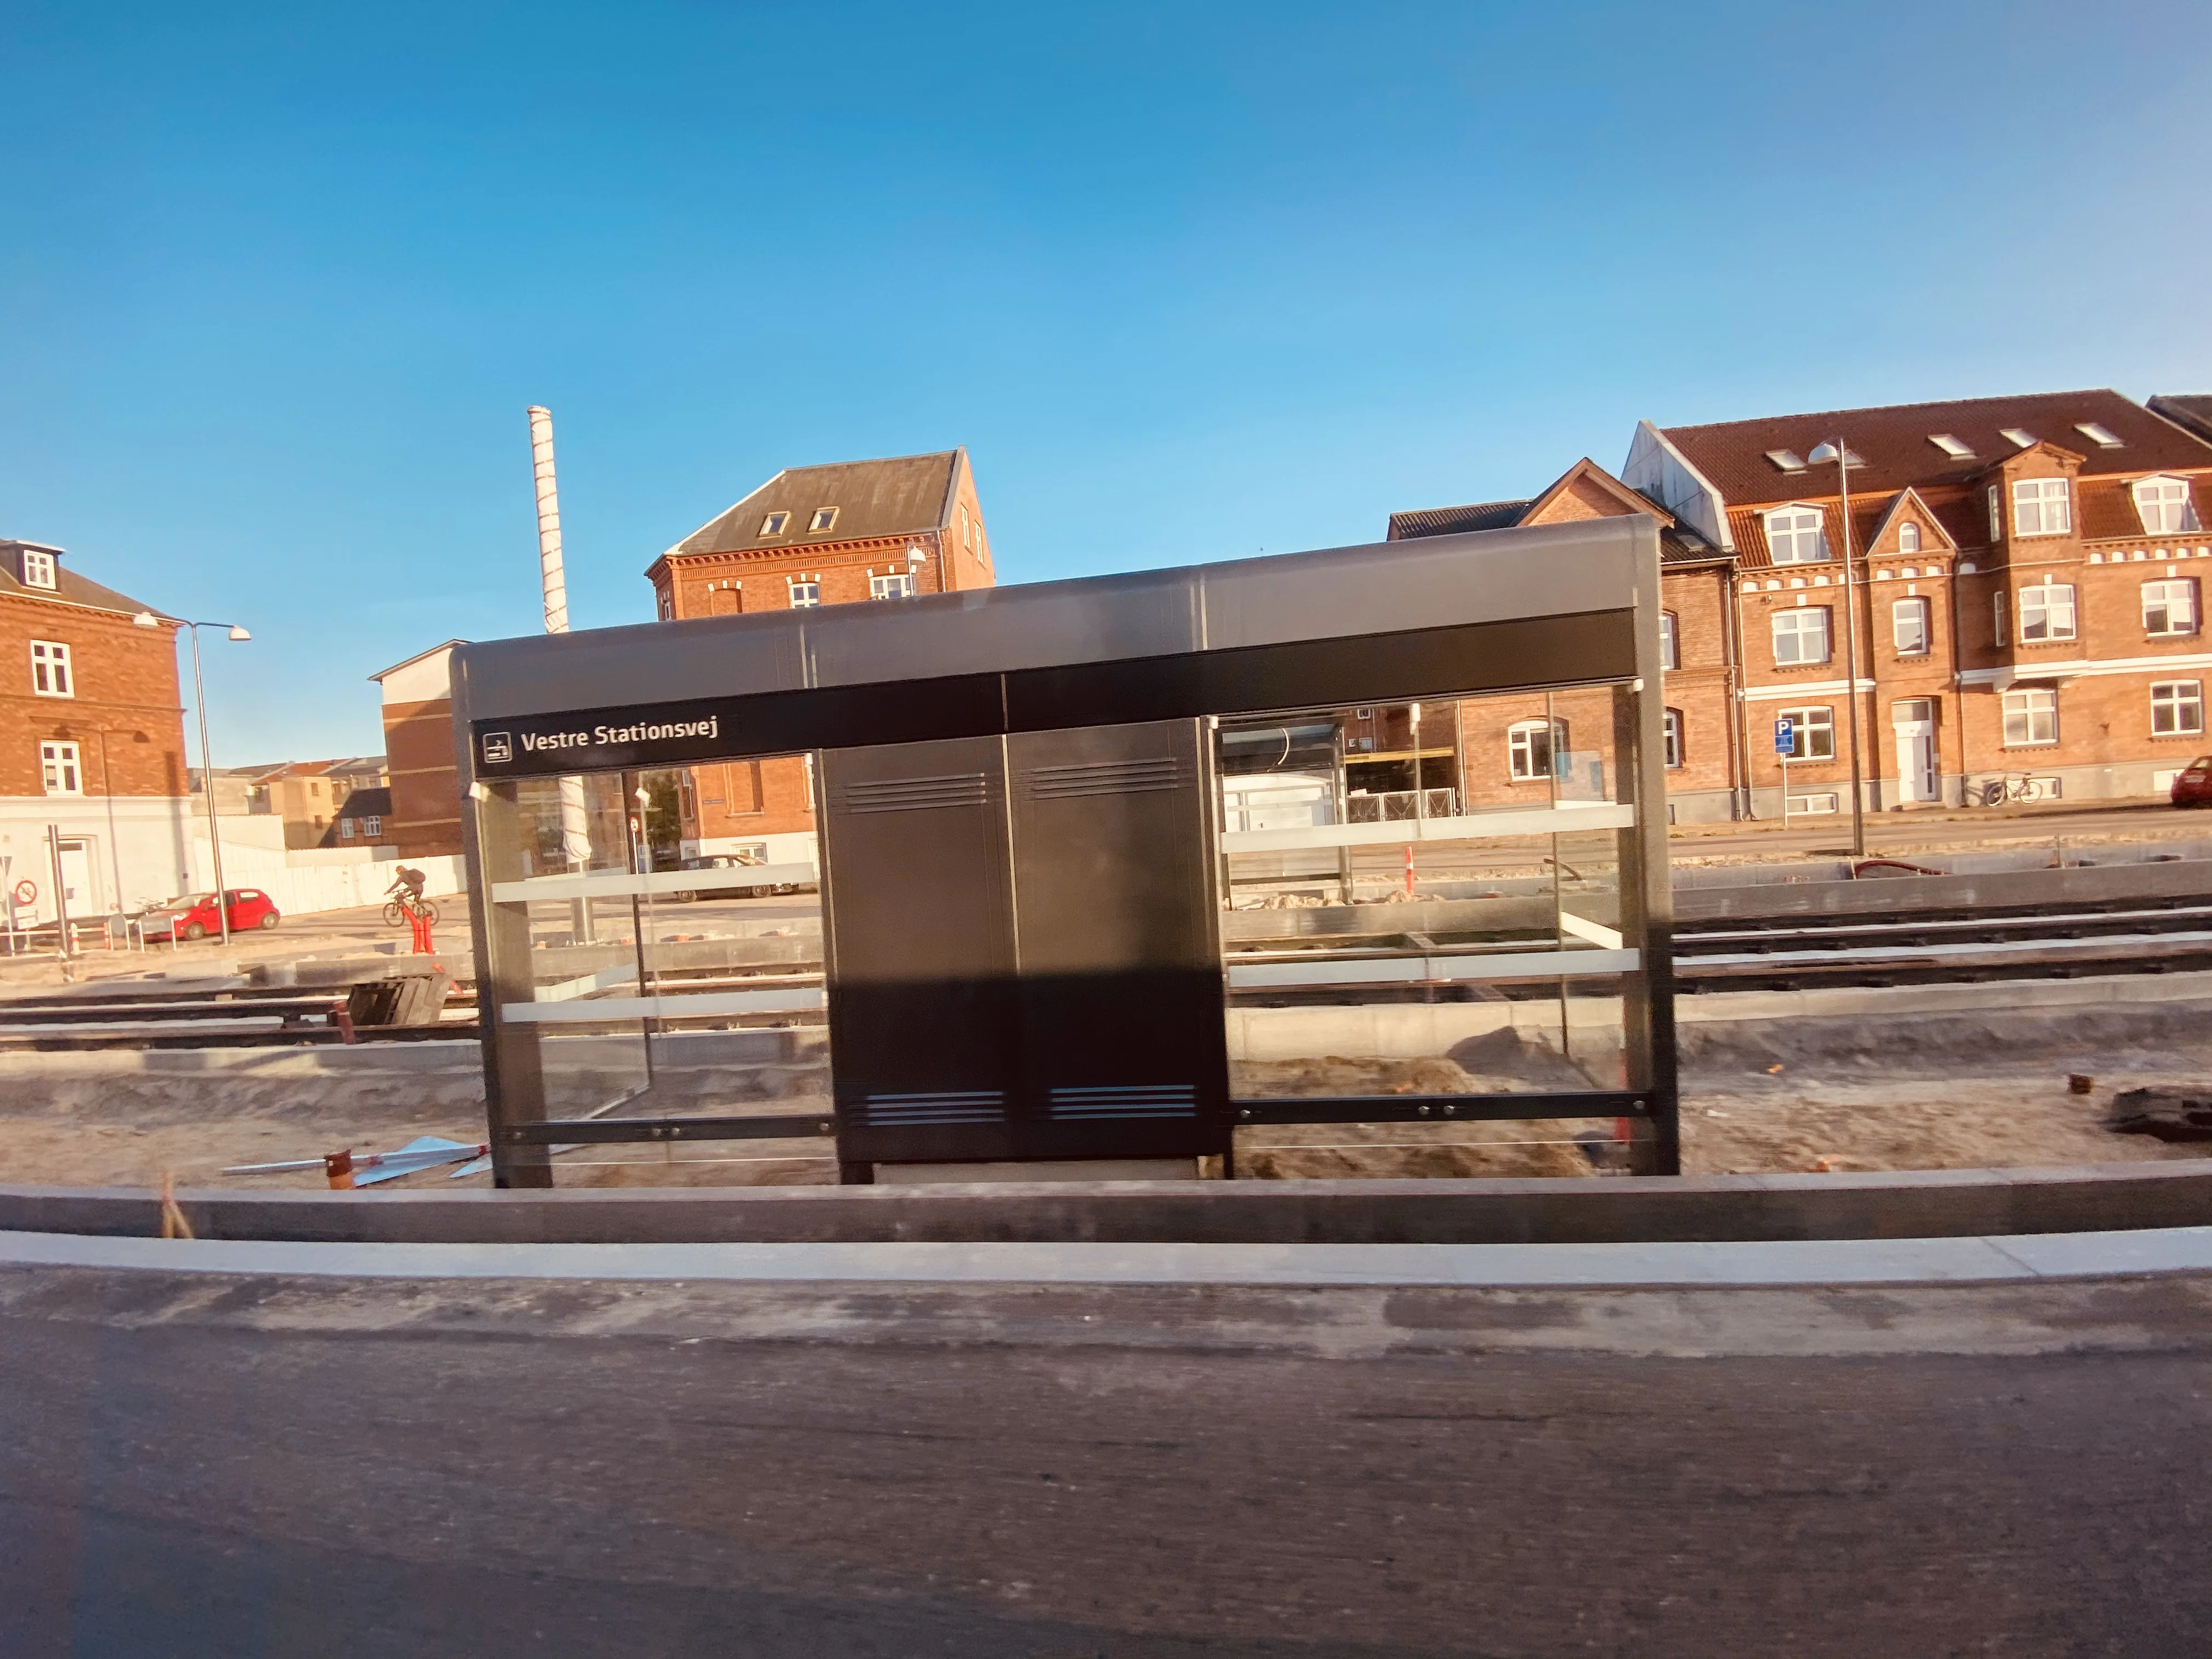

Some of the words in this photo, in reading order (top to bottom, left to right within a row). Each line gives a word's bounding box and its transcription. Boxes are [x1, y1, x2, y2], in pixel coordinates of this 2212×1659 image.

[521, 732, 589, 751] Vestre
[594, 715, 718, 744] Stationsvej
[1778, 721, 1789, 735] P
